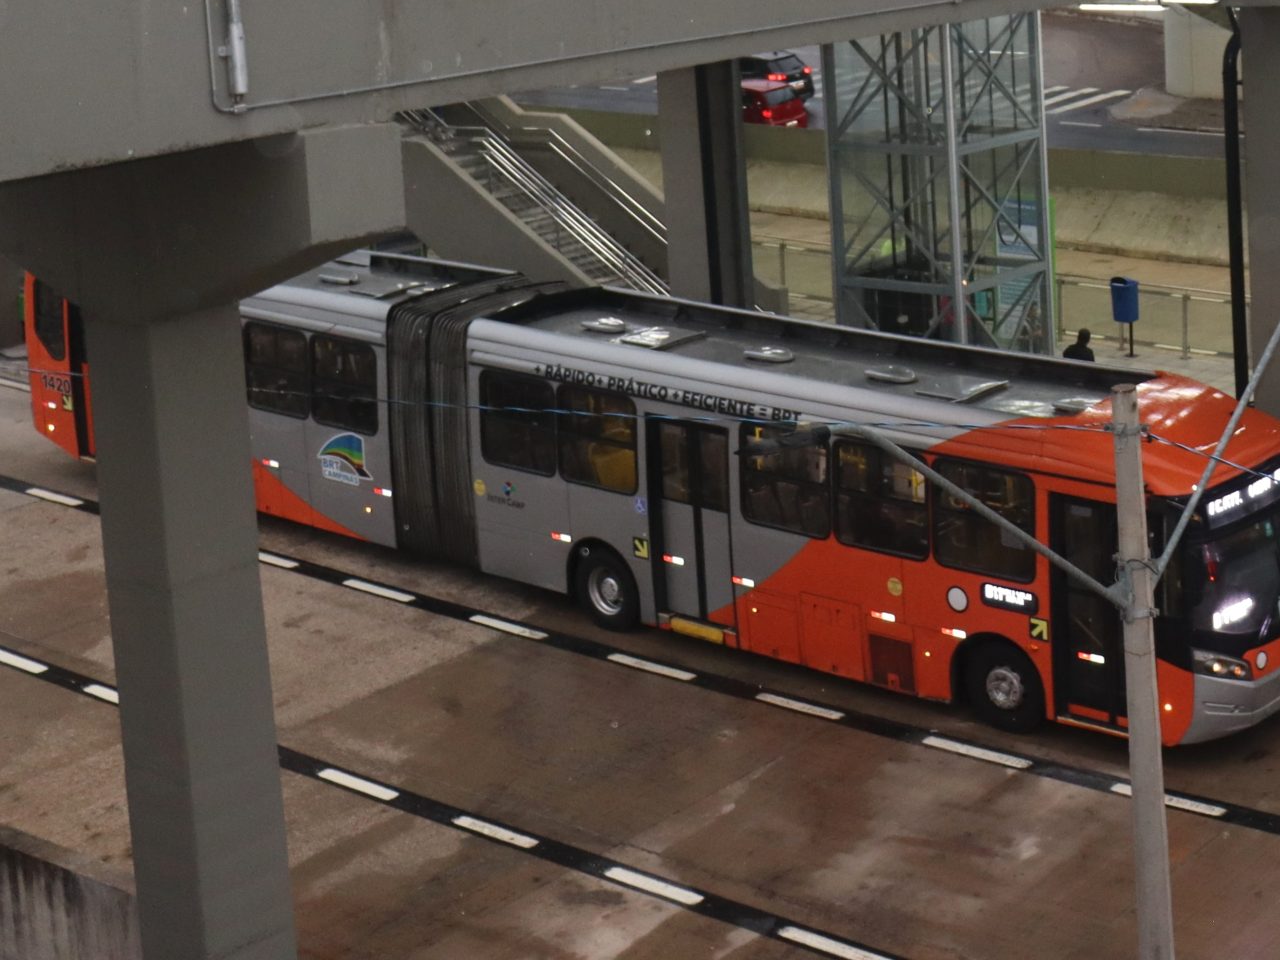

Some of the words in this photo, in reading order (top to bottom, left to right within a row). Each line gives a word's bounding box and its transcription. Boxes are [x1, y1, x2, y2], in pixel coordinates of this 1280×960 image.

[42, 374, 71, 394] 1420
[545, 364, 596, 385] RÁPIDO
[607, 376, 668, 400] PRÁTICO
[682, 390, 756, 417] EFICIENTE
[771, 407, 802, 421] BRT
[323, 458, 340, 470] BRT
